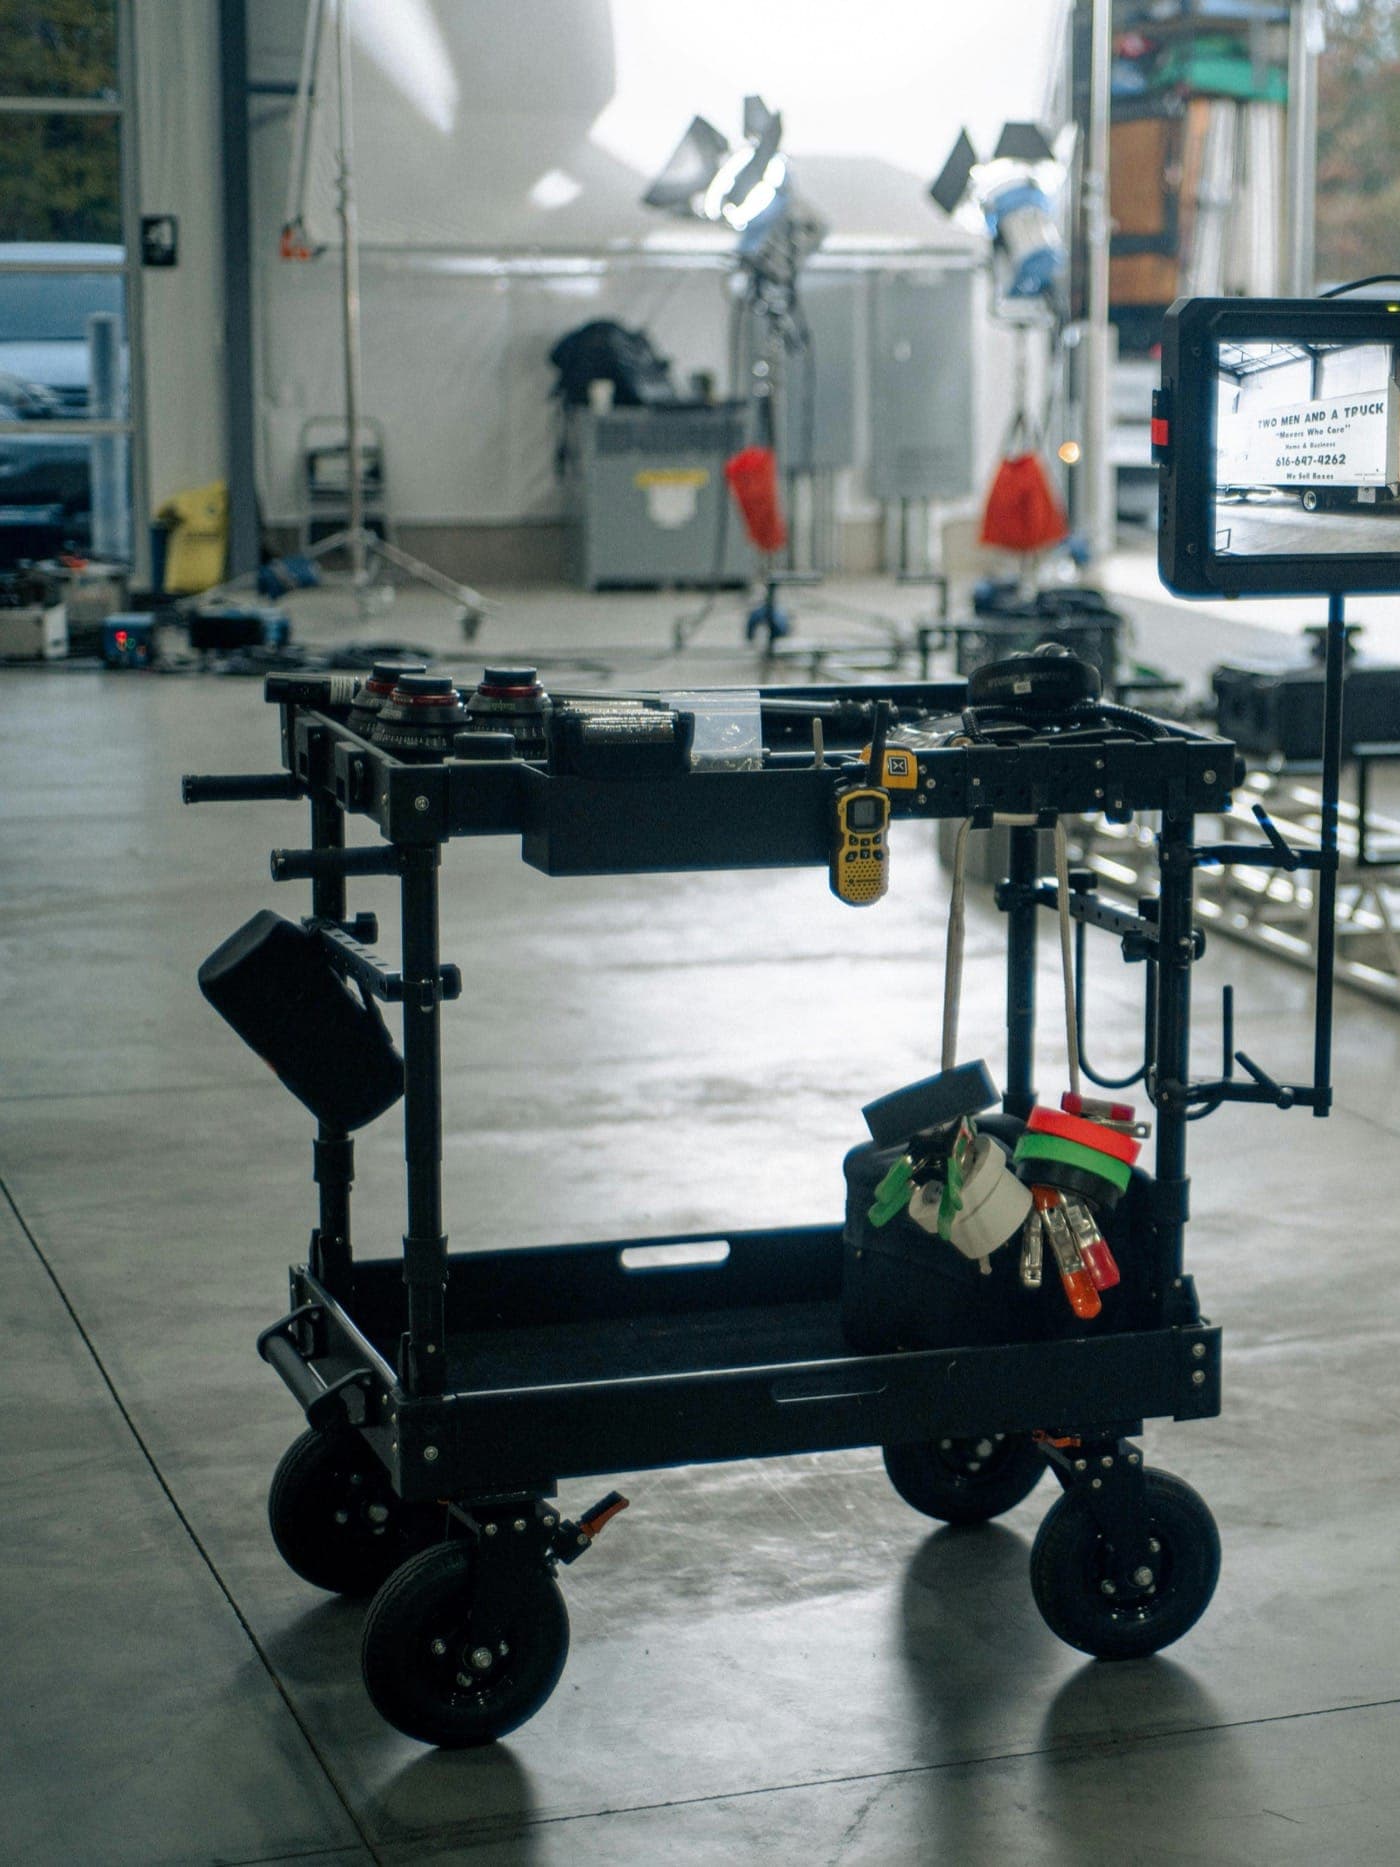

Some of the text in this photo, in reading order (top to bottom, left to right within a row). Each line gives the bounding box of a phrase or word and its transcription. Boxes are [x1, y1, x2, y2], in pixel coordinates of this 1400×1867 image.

[1258, 402, 1384, 429] TWO MEN AND A TRUCK
[1275, 454, 1346, 467] 616-647-4262
